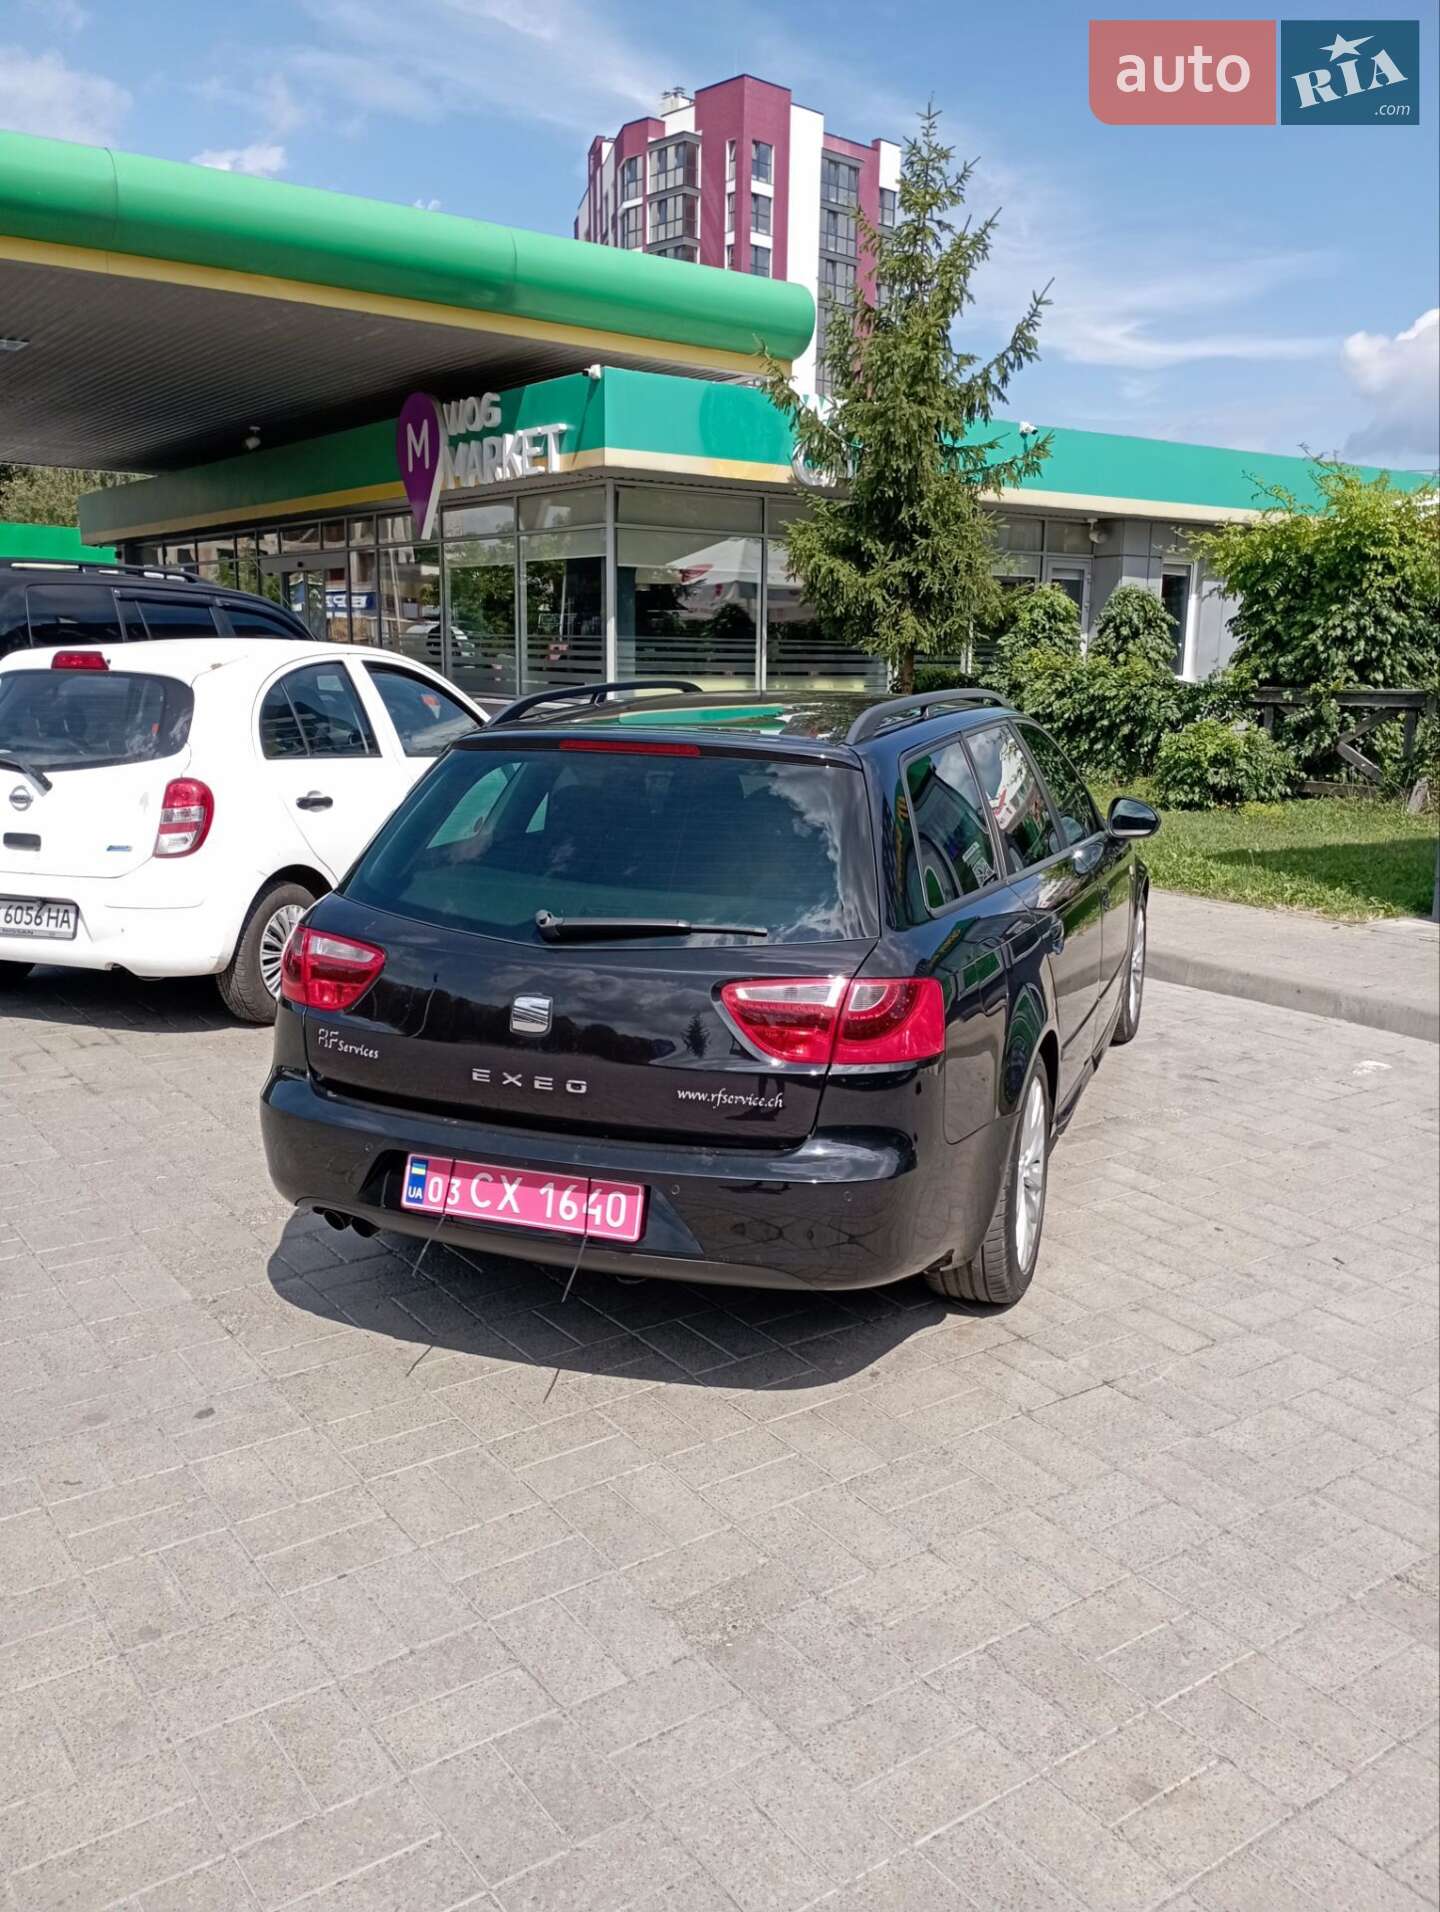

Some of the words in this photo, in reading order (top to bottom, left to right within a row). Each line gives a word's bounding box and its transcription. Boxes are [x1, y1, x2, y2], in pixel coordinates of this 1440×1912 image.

[442, 391, 502, 436] WOG
[406, 418, 430, 473] M
[442, 423, 568, 490] MARKET
[4, 904, 43, 927] 6056
[46, 907, 71, 929] HA
[337, 1040, 379, 1059] Services
[472, 1067, 587, 1094] EXEO
[676, 1088, 784, 1110] www.rfservice.ch
[407, 1185, 423, 1200] UA
[427, 1176, 461, 1205] 03
[470, 1172, 524, 1214] CX
[540, 1181, 627, 1228] 1640
